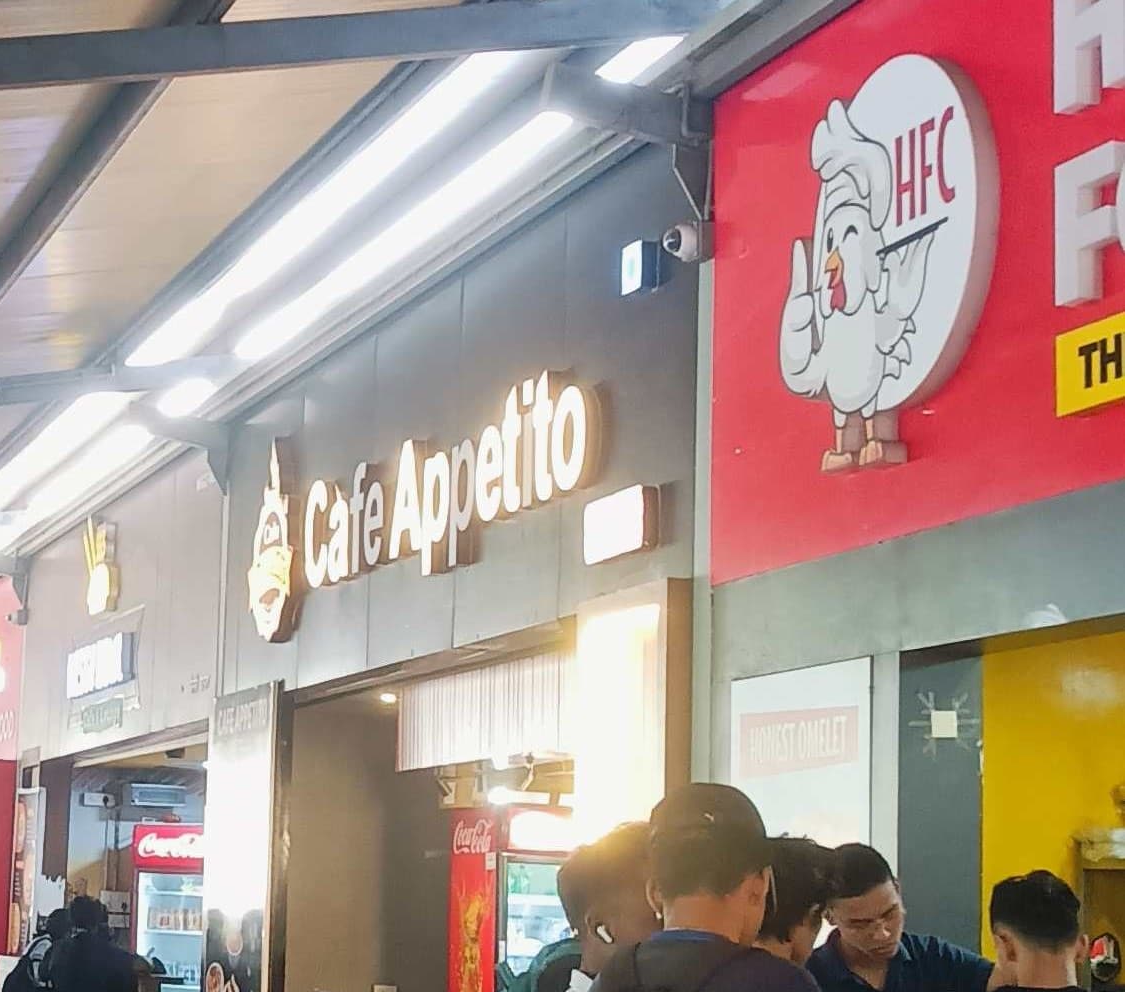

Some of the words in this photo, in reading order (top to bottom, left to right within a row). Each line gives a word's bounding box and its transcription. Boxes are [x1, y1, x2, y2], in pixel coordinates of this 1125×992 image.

[894, 105, 956, 228] HFC
[304, 461, 387, 589] Cafe
[388, 369, 588, 577] Appetito
